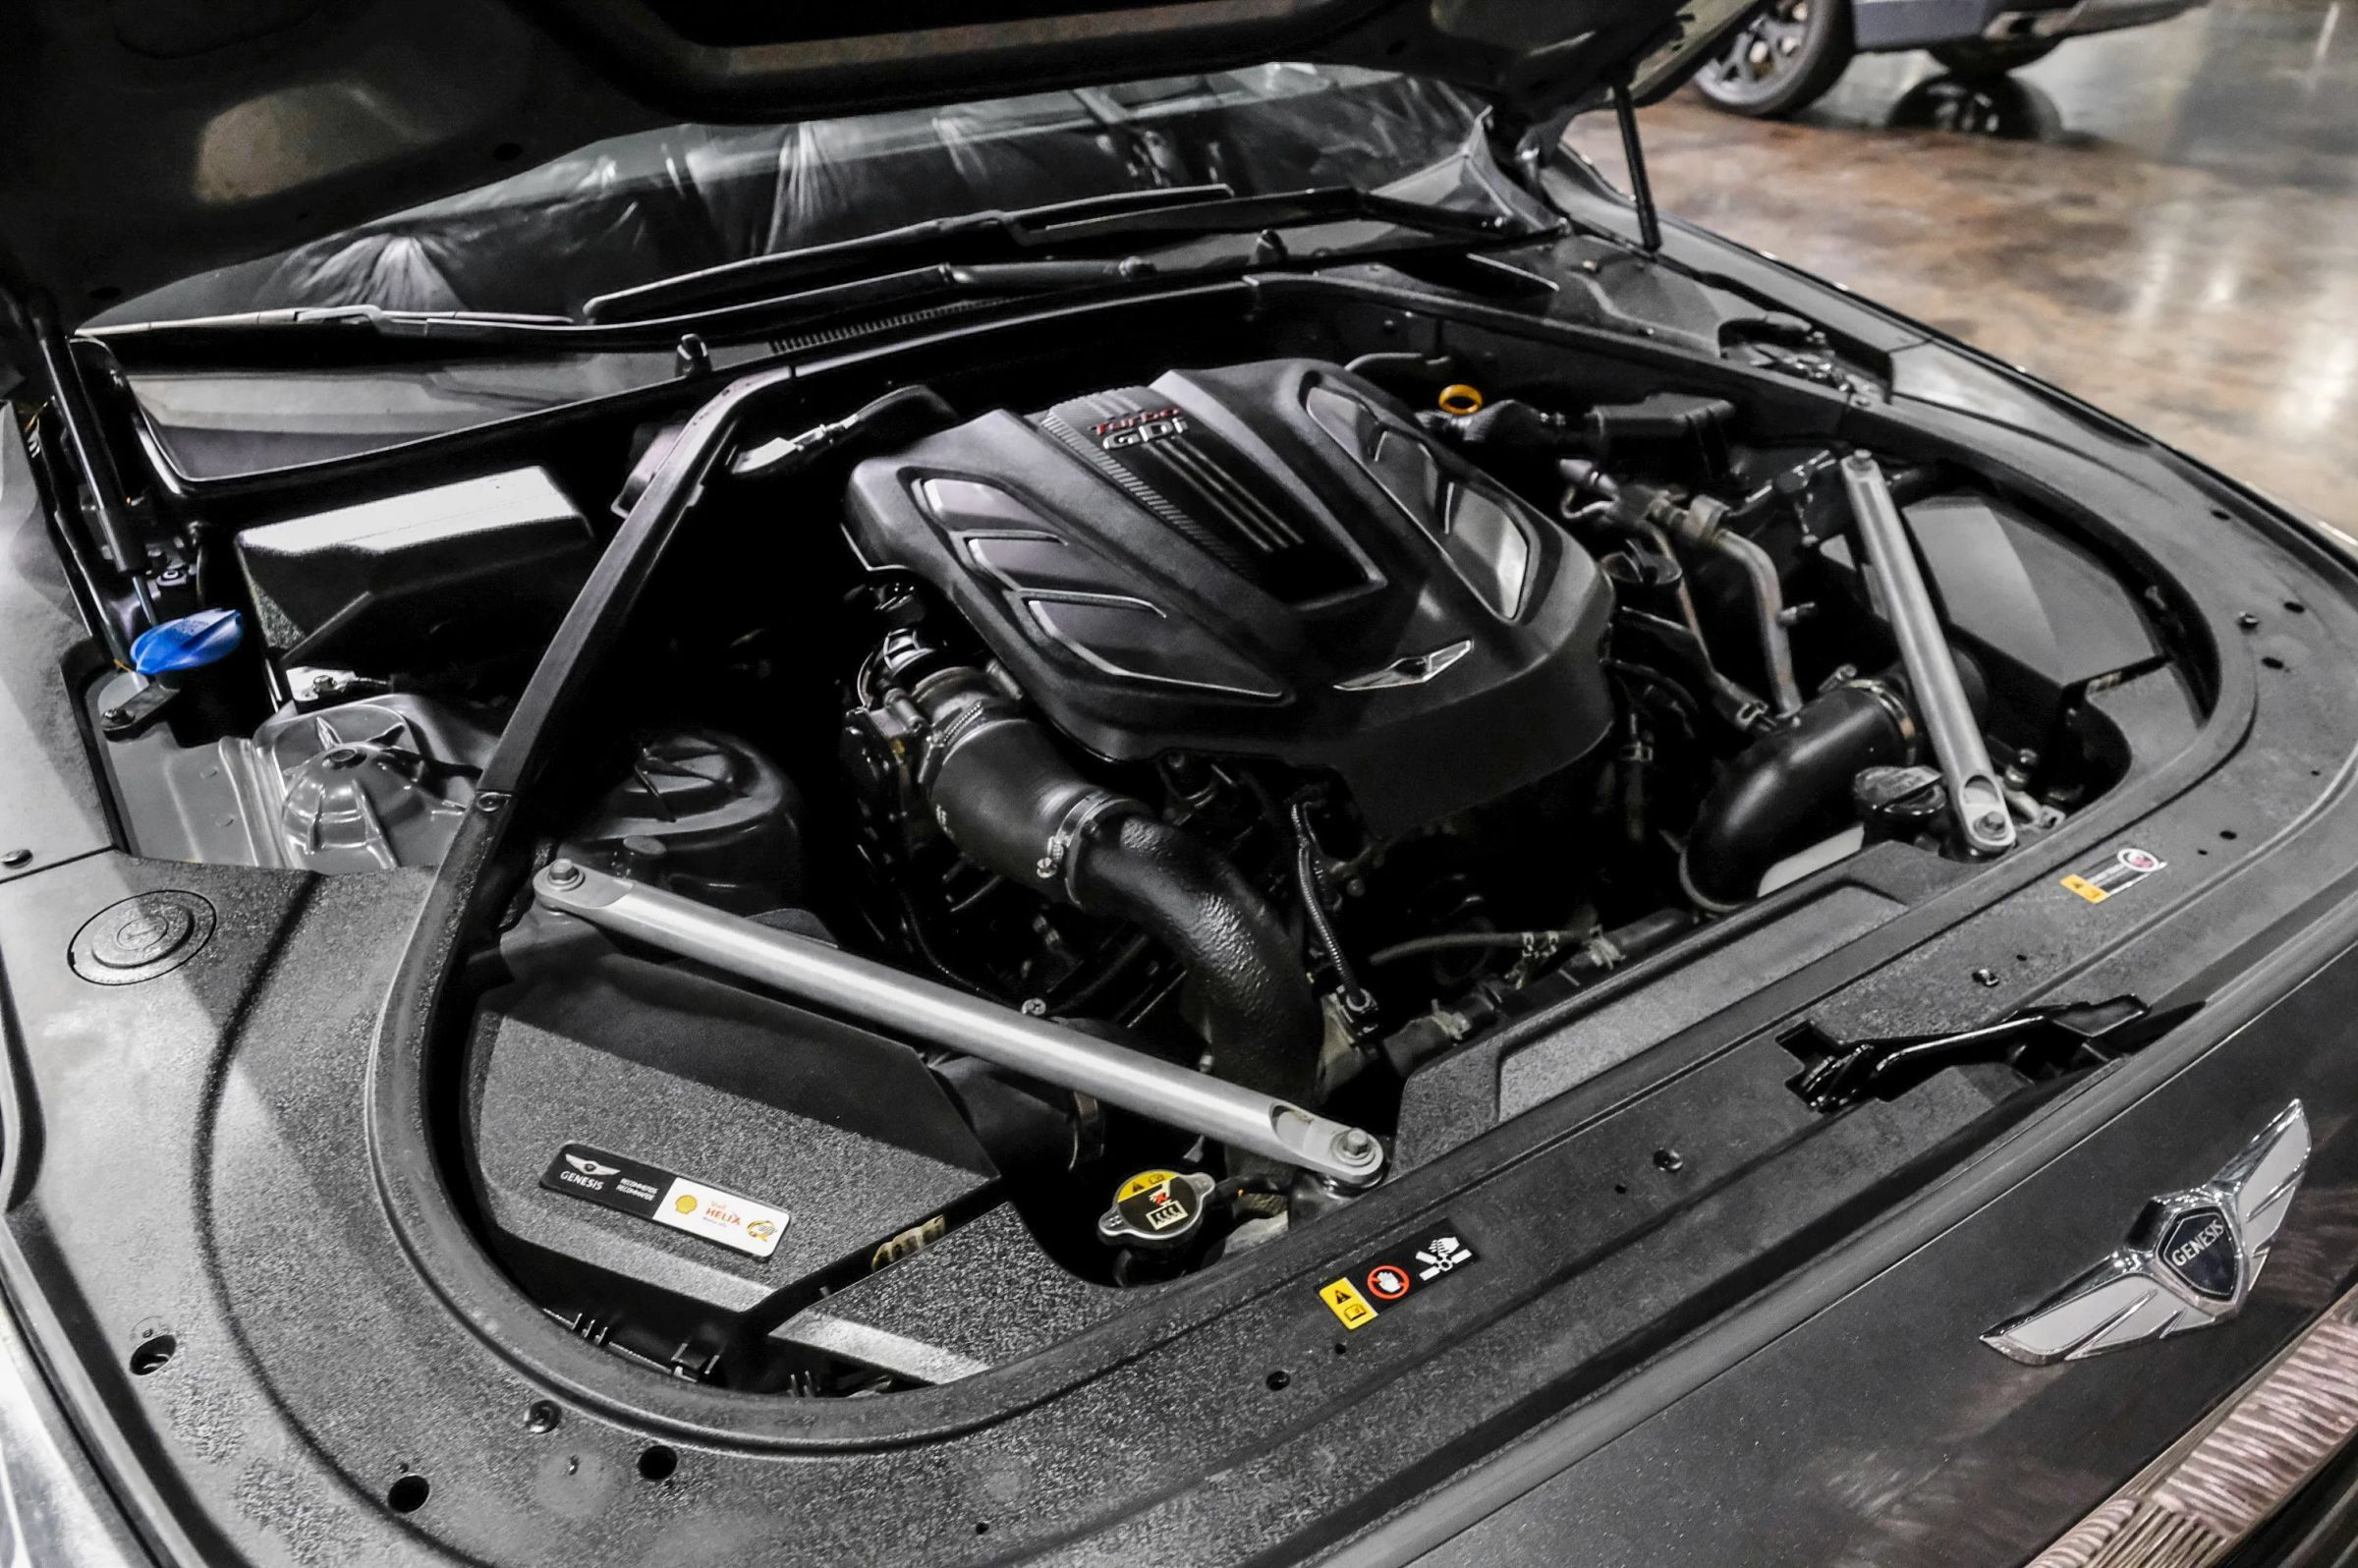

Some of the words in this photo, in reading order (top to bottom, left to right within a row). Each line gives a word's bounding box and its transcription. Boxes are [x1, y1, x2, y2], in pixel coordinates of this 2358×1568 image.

[560, 1170, 605, 1191] GENESIS
[704, 1207, 742, 1226] HELIX
[2171, 1218, 2224, 1266] GENESIS
